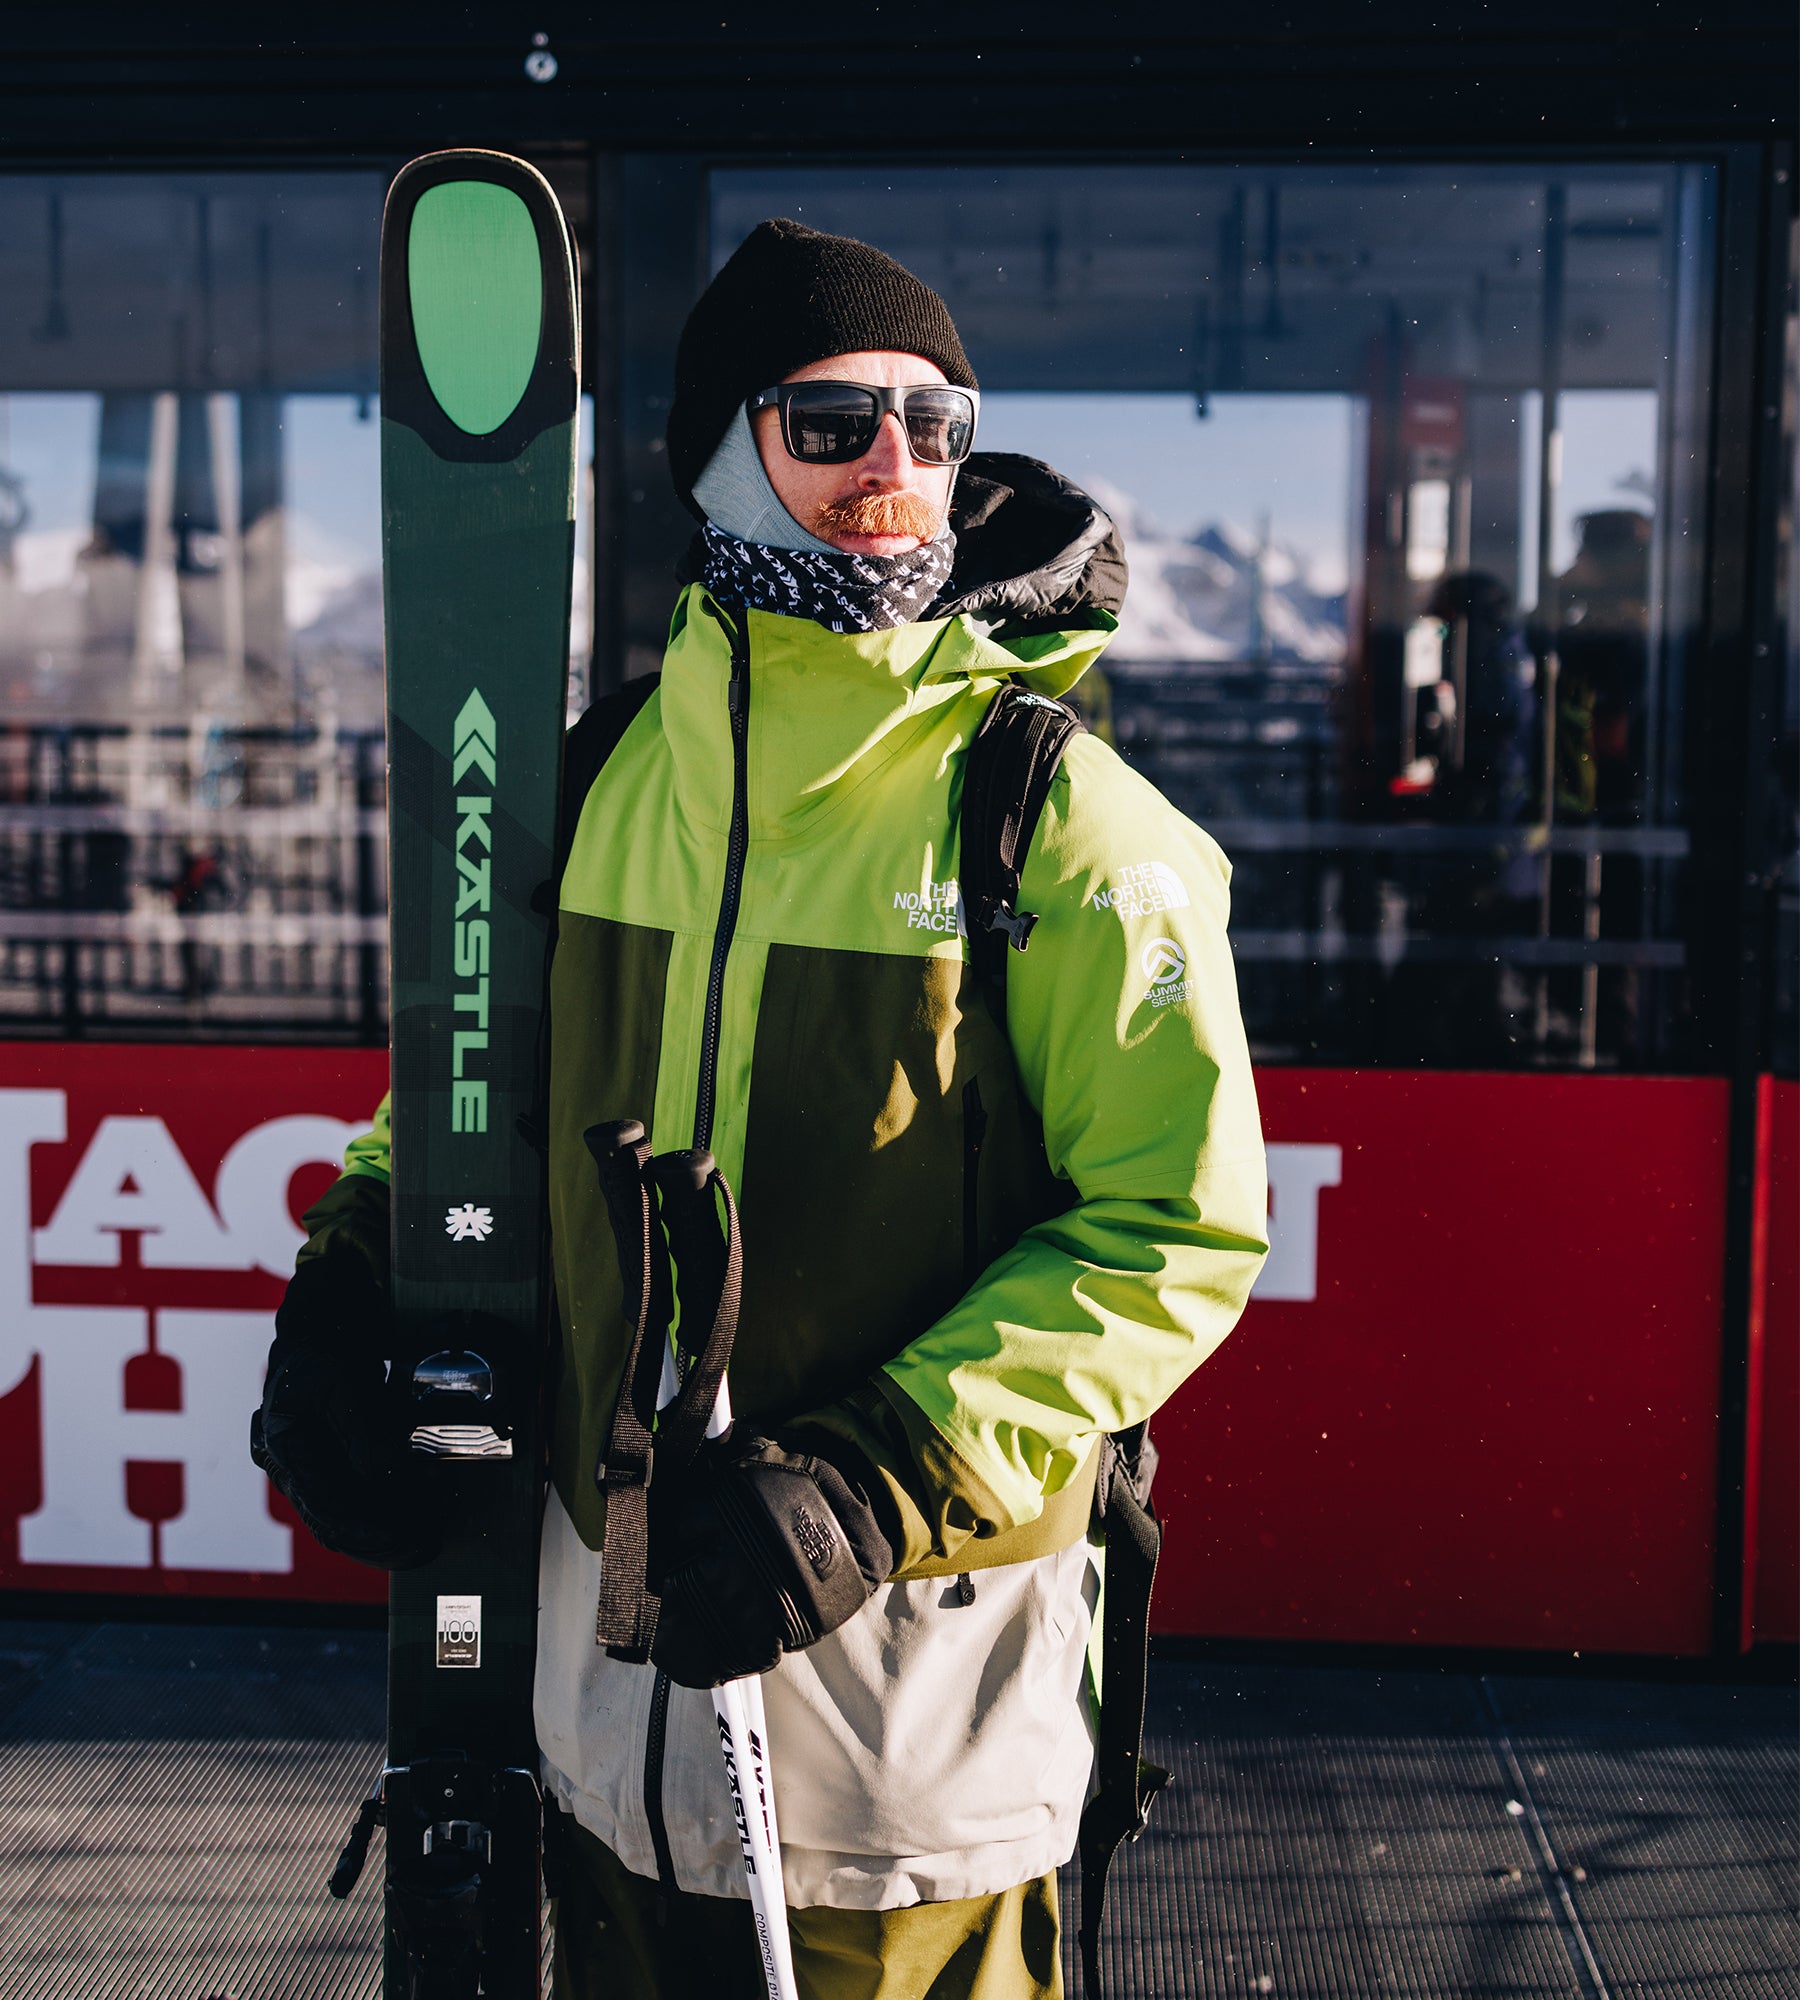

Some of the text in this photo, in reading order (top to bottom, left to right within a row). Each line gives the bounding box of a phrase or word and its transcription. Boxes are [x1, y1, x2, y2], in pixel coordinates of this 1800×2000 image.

[1117, 861, 1153, 884] THE
[1092, 878, 1161, 911] NORTH
[1118, 894, 1165, 922] FACE
[907, 910, 957, 933] FACE
[452, 796, 492, 1132] KASTLE
[1143, 979, 1195, 1000] SUMMIT
[1151, 990, 1193, 1008] SERIES
[443, 1620, 475, 1643] 100
[756, 1912, 776, 1980] COMPOSITE
